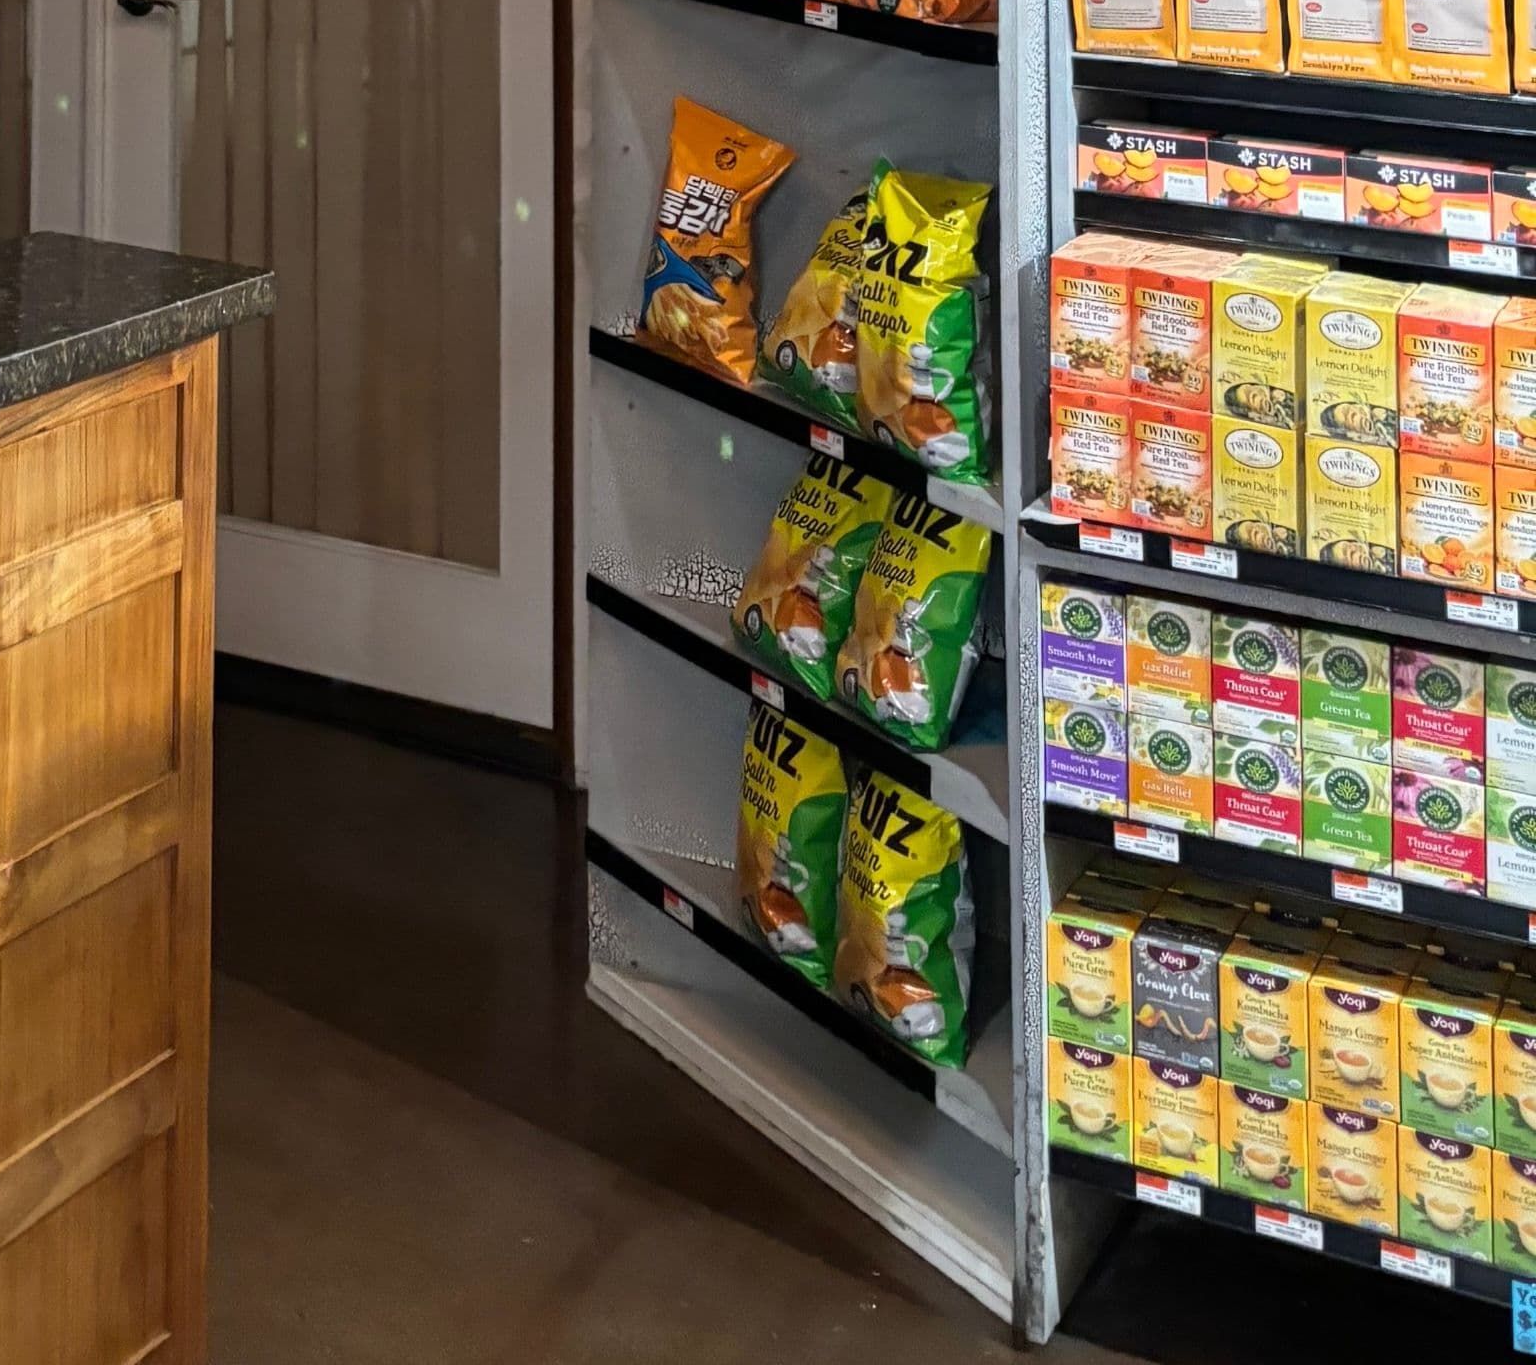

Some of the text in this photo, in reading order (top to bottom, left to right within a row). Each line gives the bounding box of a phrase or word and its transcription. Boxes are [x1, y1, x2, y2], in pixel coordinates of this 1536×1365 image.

[1126, 136, 1177, 155] STASH
[1258, 153, 1312, 172] STASH
[1399, 169, 1456, 189] STASH
[683, 174, 739, 207] 담백한
[1062, 279, 1121, 299] TWININGS
[1141, 290, 1200, 312] TWININGS
[857, 306, 913, 338] inegar
[1092, 312, 1109, 322] Tea
[1230, 306, 1278, 323] TWININGS
[1171, 325, 1187, 336] Tea
[1325, 324, 1378, 341] TWININGS
[1220, 338, 1287, 361] Lemon Delight
[1411, 337, 1479, 358] TWININGS
[1315, 356, 1349, 371] Lemon
[1410, 357, 1435, 370] Pure
[1062, 408, 1121, 429] TWININGS
[1141, 422, 1201, 445] TWININGS
[1229, 442, 1278, 459] TWININGS
[1324, 461, 1376, 478] TWININGS
[790, 480, 821, 509] Salt
[778, 499, 837, 539] Vinegar
[877, 529, 907, 555] Salt
[866, 551, 917, 588] Vinegar
[1048, 645, 1085, 662] Smooth
[1224, 679, 1287, 701] Throat Coat
[1320, 701, 1371, 720] Green Tea
[1406, 714, 1441, 730] Throat
[744, 752, 766, 784] Salt
[1051, 760, 1089, 776] Smooth
[1226, 798, 1288, 819] Throat Coat
[1322, 823, 1353, 838] Green
[849, 830, 868, 863] Salt
[1136, 974, 1179, 1000] Orange
[1237, 999, 1289, 1021] Kombucha
[1319, 1019, 1353, 1037] Mango
